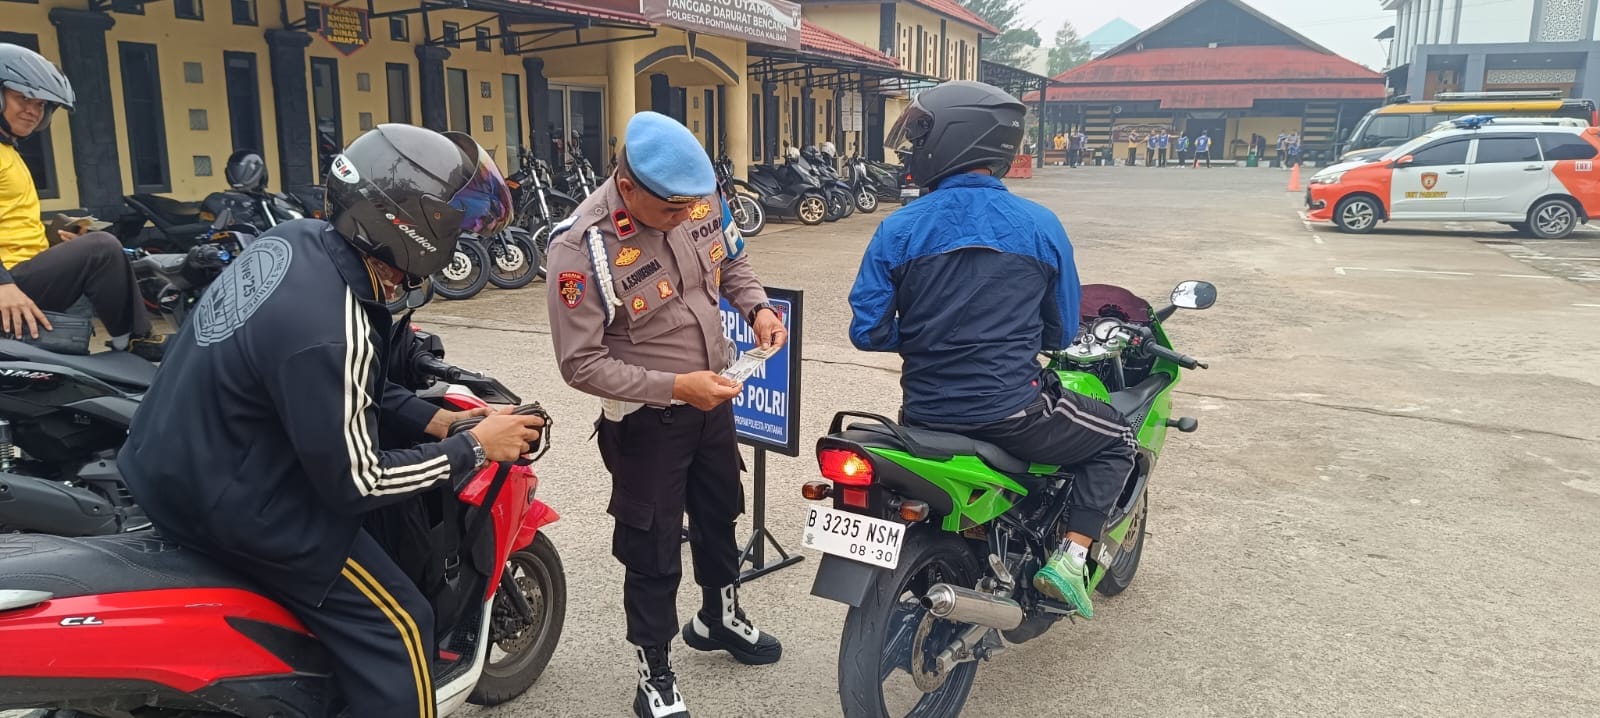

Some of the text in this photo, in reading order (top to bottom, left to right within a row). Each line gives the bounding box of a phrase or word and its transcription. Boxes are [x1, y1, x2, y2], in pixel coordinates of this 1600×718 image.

[666, 9, 787, 42] POLRESTA PONTIANAK POLDA KALBAR
[667, 0, 787, 33] TANGGAP DARURAT BENCANA
[335, 158, 351, 178] GM
[691, 217, 722, 242] POLRI
[747, 384, 785, 417] POLRI
[808, 509, 900, 548] B 3235 NSM
[60, 616, 103, 626] CL
